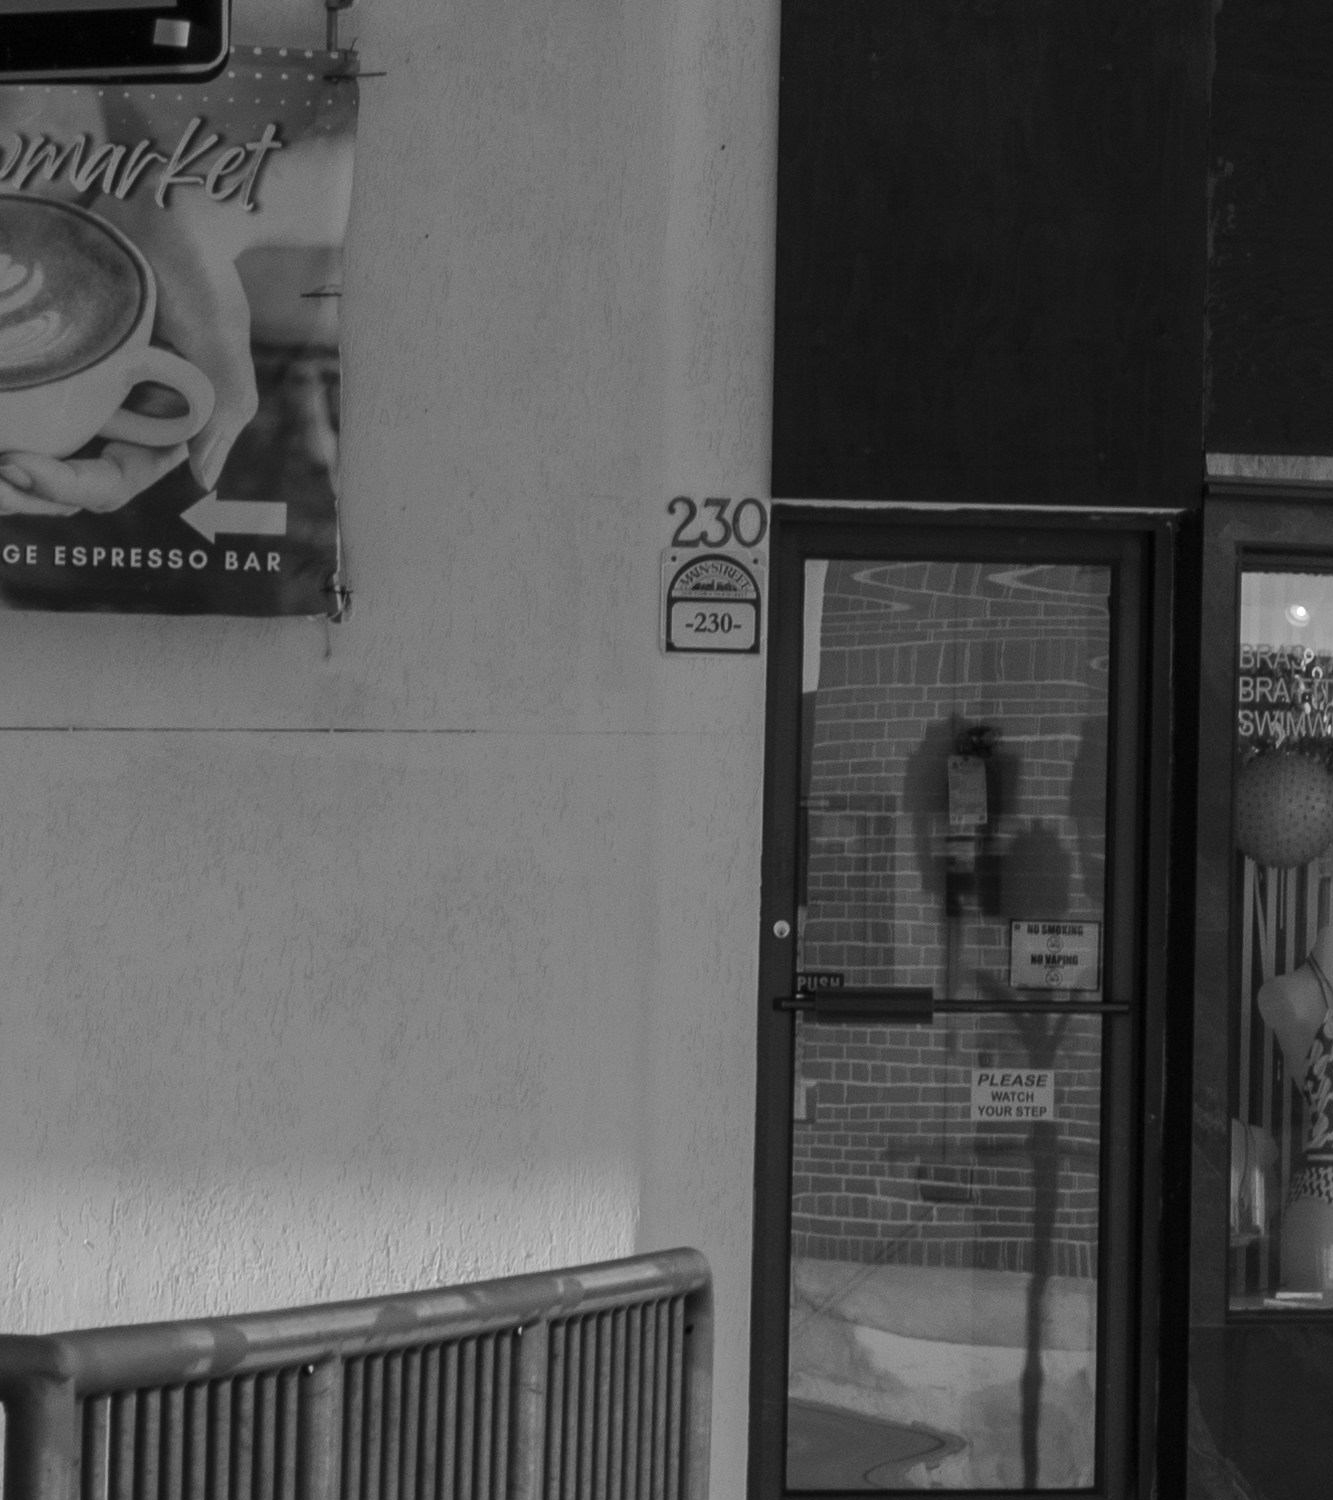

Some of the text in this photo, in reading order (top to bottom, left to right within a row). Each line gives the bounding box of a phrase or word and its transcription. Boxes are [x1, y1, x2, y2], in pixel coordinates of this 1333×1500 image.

[667, 495, 768, 549] 230
[55, 545, 208, 570] ESPRESSO
[225, 551, 282, 573] BAR
[1239, 676, 1291, 703] BRA
[1027, 924, 1040, 935] NO
[1041, 924, 1084, 936] SMOKING
[1030, 954, 1078, 966] NO VAPING
[977, 1073, 1049, 1087] PLEASE
[991, 1091, 1034, 1103] WATCH
[978, 1105, 1047, 1117] YOUR STEP
